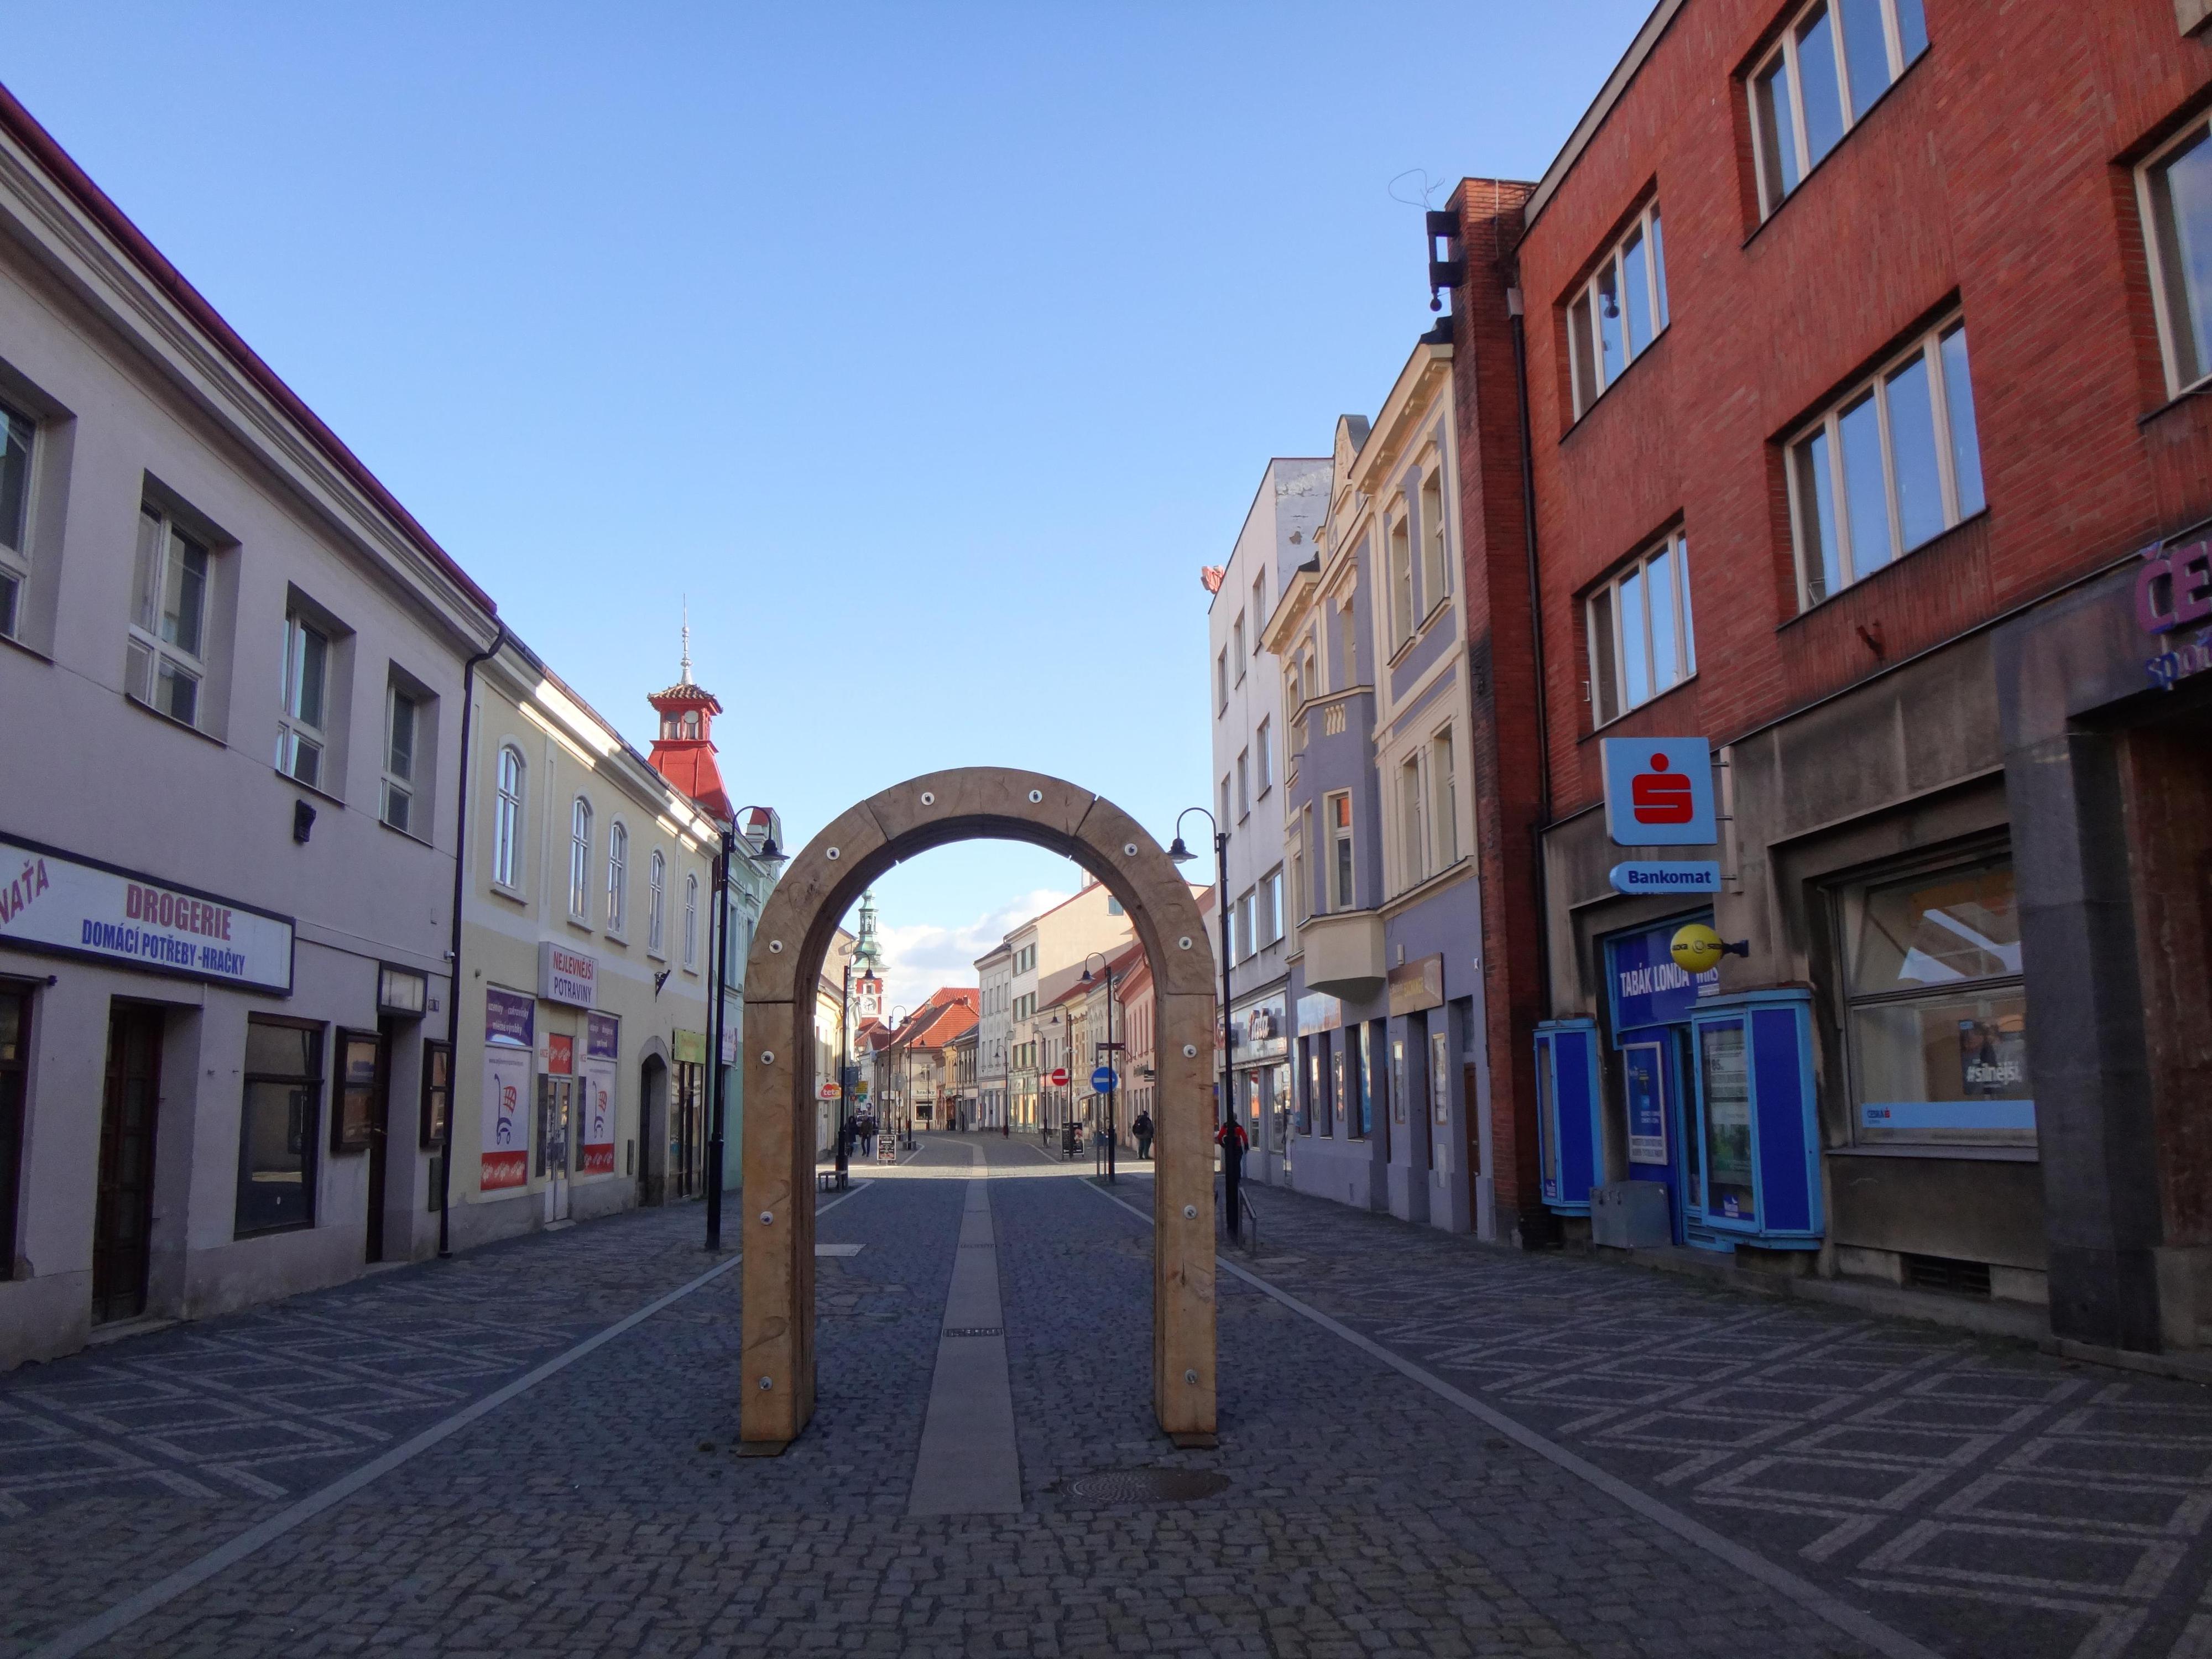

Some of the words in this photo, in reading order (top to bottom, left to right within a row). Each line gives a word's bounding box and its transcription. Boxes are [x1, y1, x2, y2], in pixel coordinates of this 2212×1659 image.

[2136, 539, 2212, 634] ČE
[1628, 870, 1712, 885] Bankomat
[126, 883, 232, 941] DROGERIE
[82, 918, 140, 954] DOMÁCÍ
[142, 933, 197, 967] POTŘEBY
[553, 951, 594, 980] NEJLEVNĚJŠÍ
[1620, 962, 1653, 998] TABÁK
[554, 976, 592, 1003] POTRAVINY
